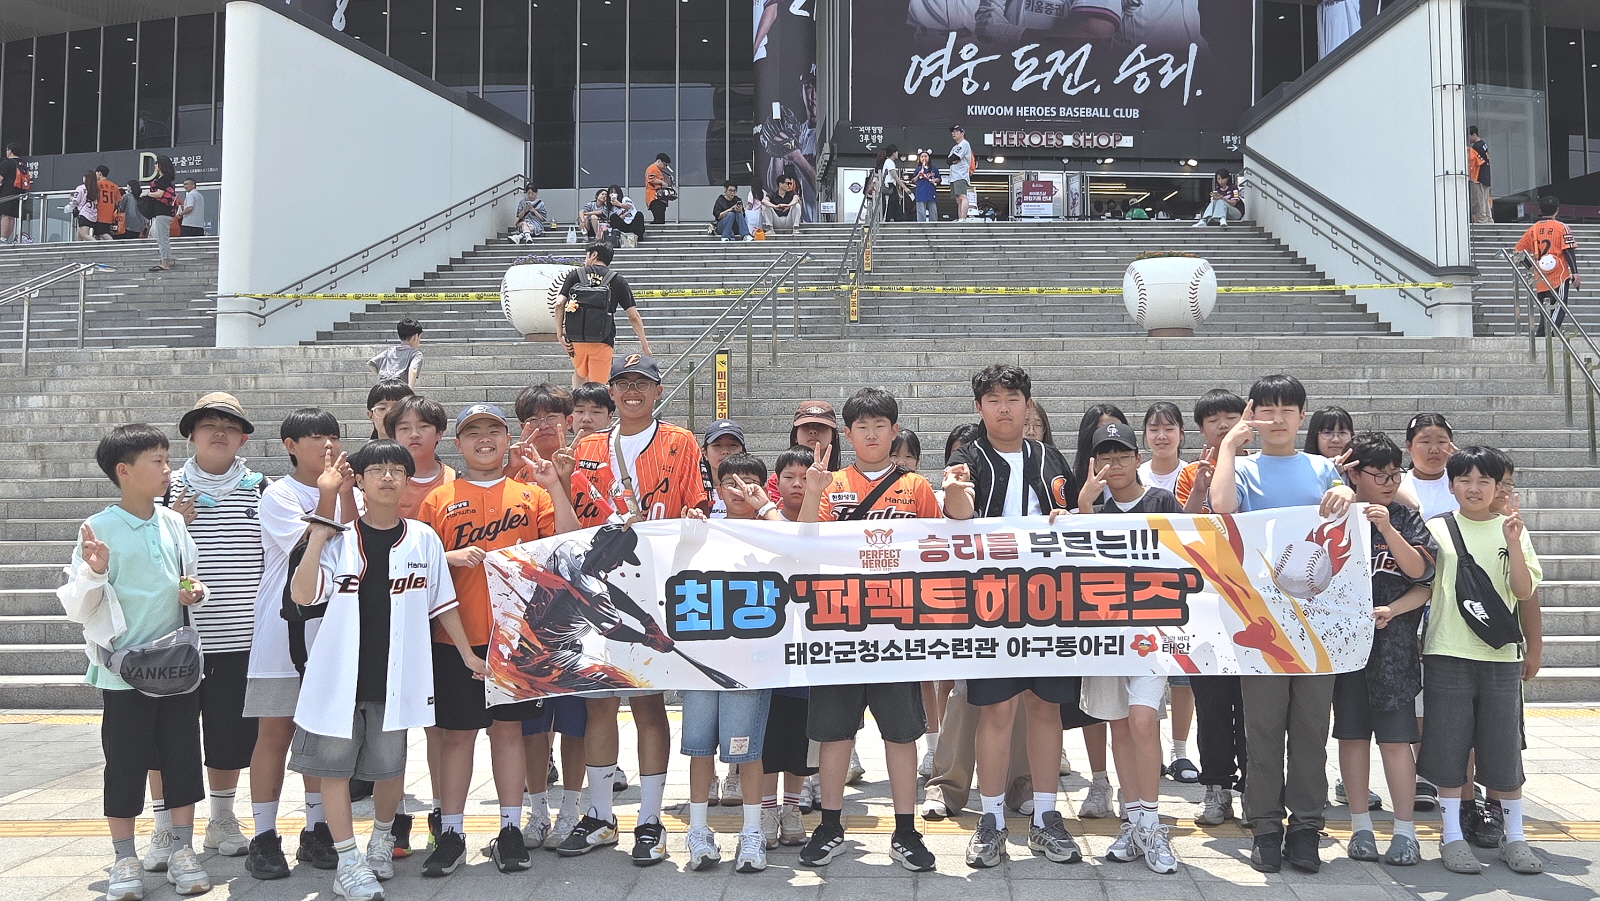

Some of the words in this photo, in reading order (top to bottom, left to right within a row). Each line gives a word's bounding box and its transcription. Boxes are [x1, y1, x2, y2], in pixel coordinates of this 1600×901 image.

[967, 105, 1013, 117] KIWOOM
[1016, 106, 1056, 117] HEROES
[1059, 107, 1111, 118] BASEBALL
[1113, 107, 1140, 119] CLUB
[992, 131, 1064, 148] HEROES
[1072, 132, 1123, 149] SHOP
[454, 508, 529, 550] Eagles
[859, 549, 902, 560] PERFECT
[918, 533, 1019, 563] 승리를
[1029, 529, 1160, 560] 부르는!!!
[862, 559, 899, 568] HEROES
[675, 579, 780, 632] 최강
[1471, 601, 1490, 620] NIKE
[784, 637, 1000, 666] 태안군청소년수련관
[1007, 634, 1125, 659] 야구동아리
[1161, 642, 1191, 654] 태안
[125, 663, 195, 680] YANKEES
